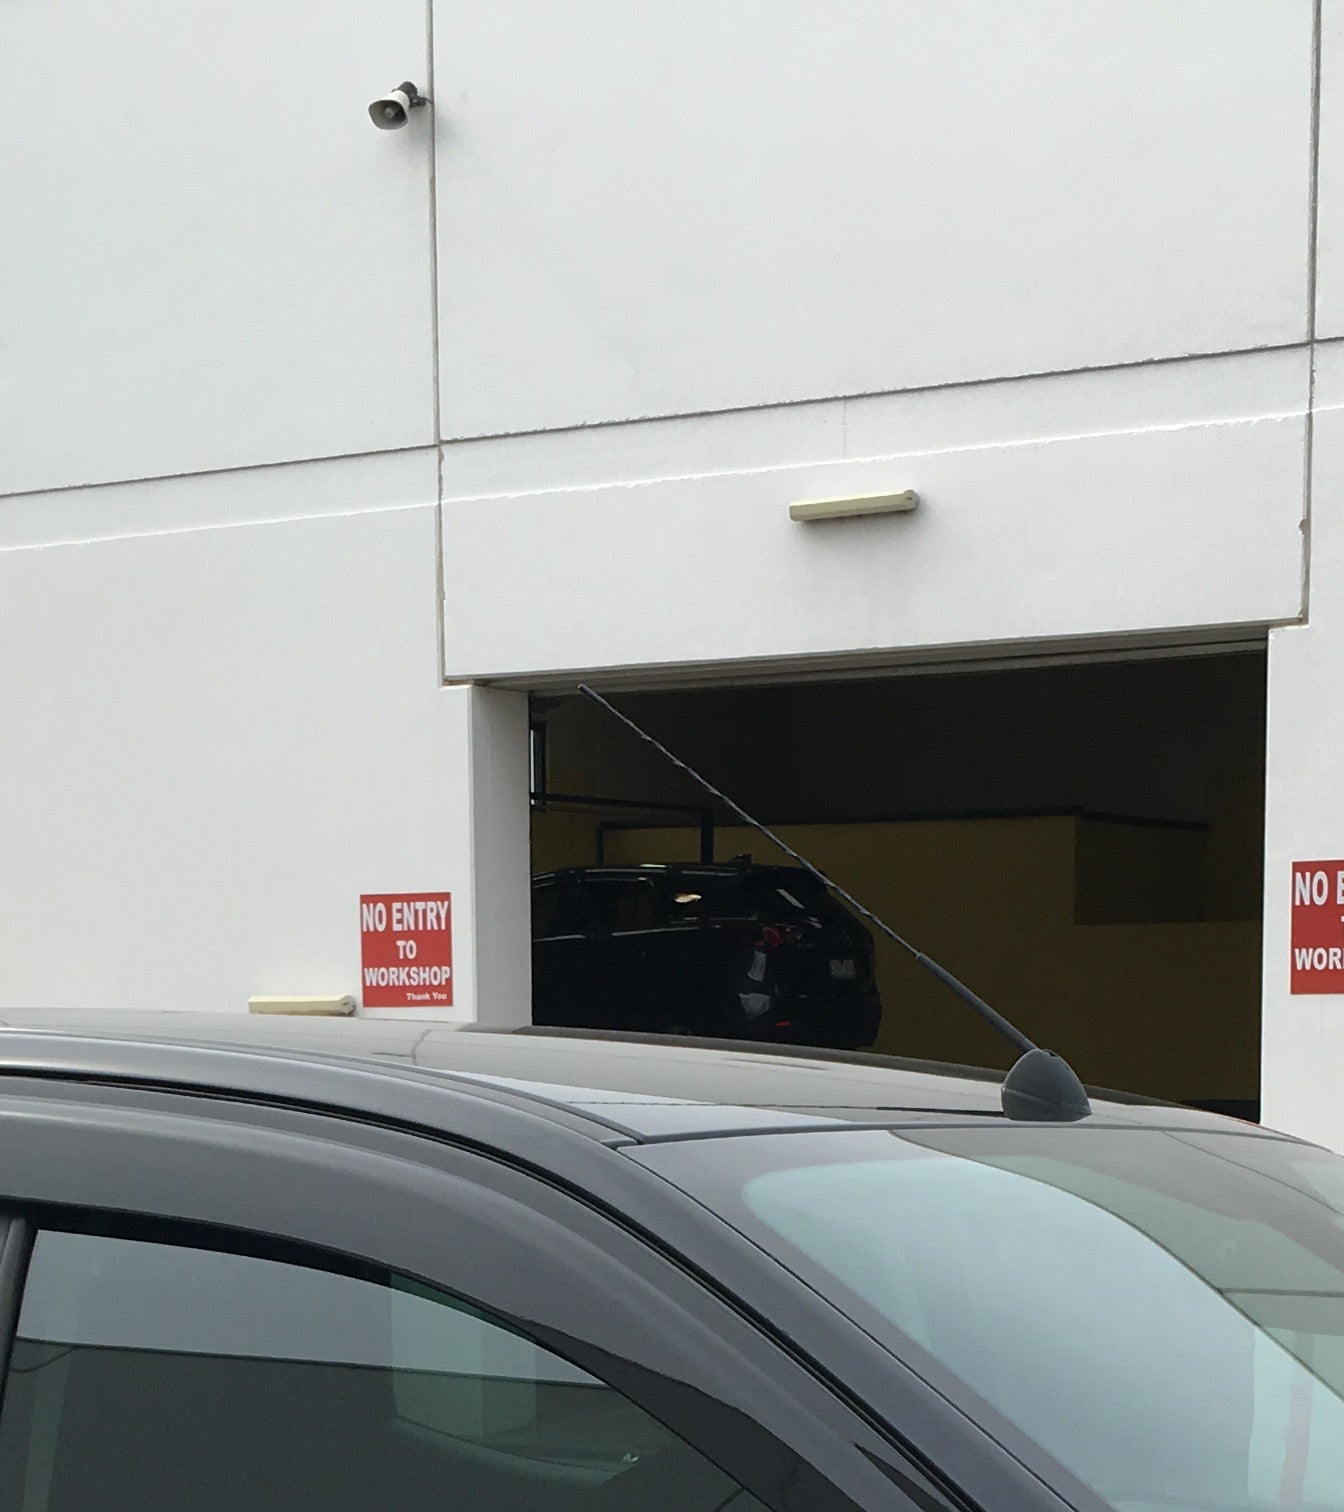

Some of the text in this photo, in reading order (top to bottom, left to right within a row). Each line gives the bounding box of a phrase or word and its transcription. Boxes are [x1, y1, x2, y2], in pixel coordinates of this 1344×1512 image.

[1294, 871, 1329, 906] NO
[362, 901, 449, 932] NO ENTRY
[396, 940, 417, 959] TO
[364, 966, 451, 987] WORKSHOP
[406, 992, 447, 1001] Thank You
